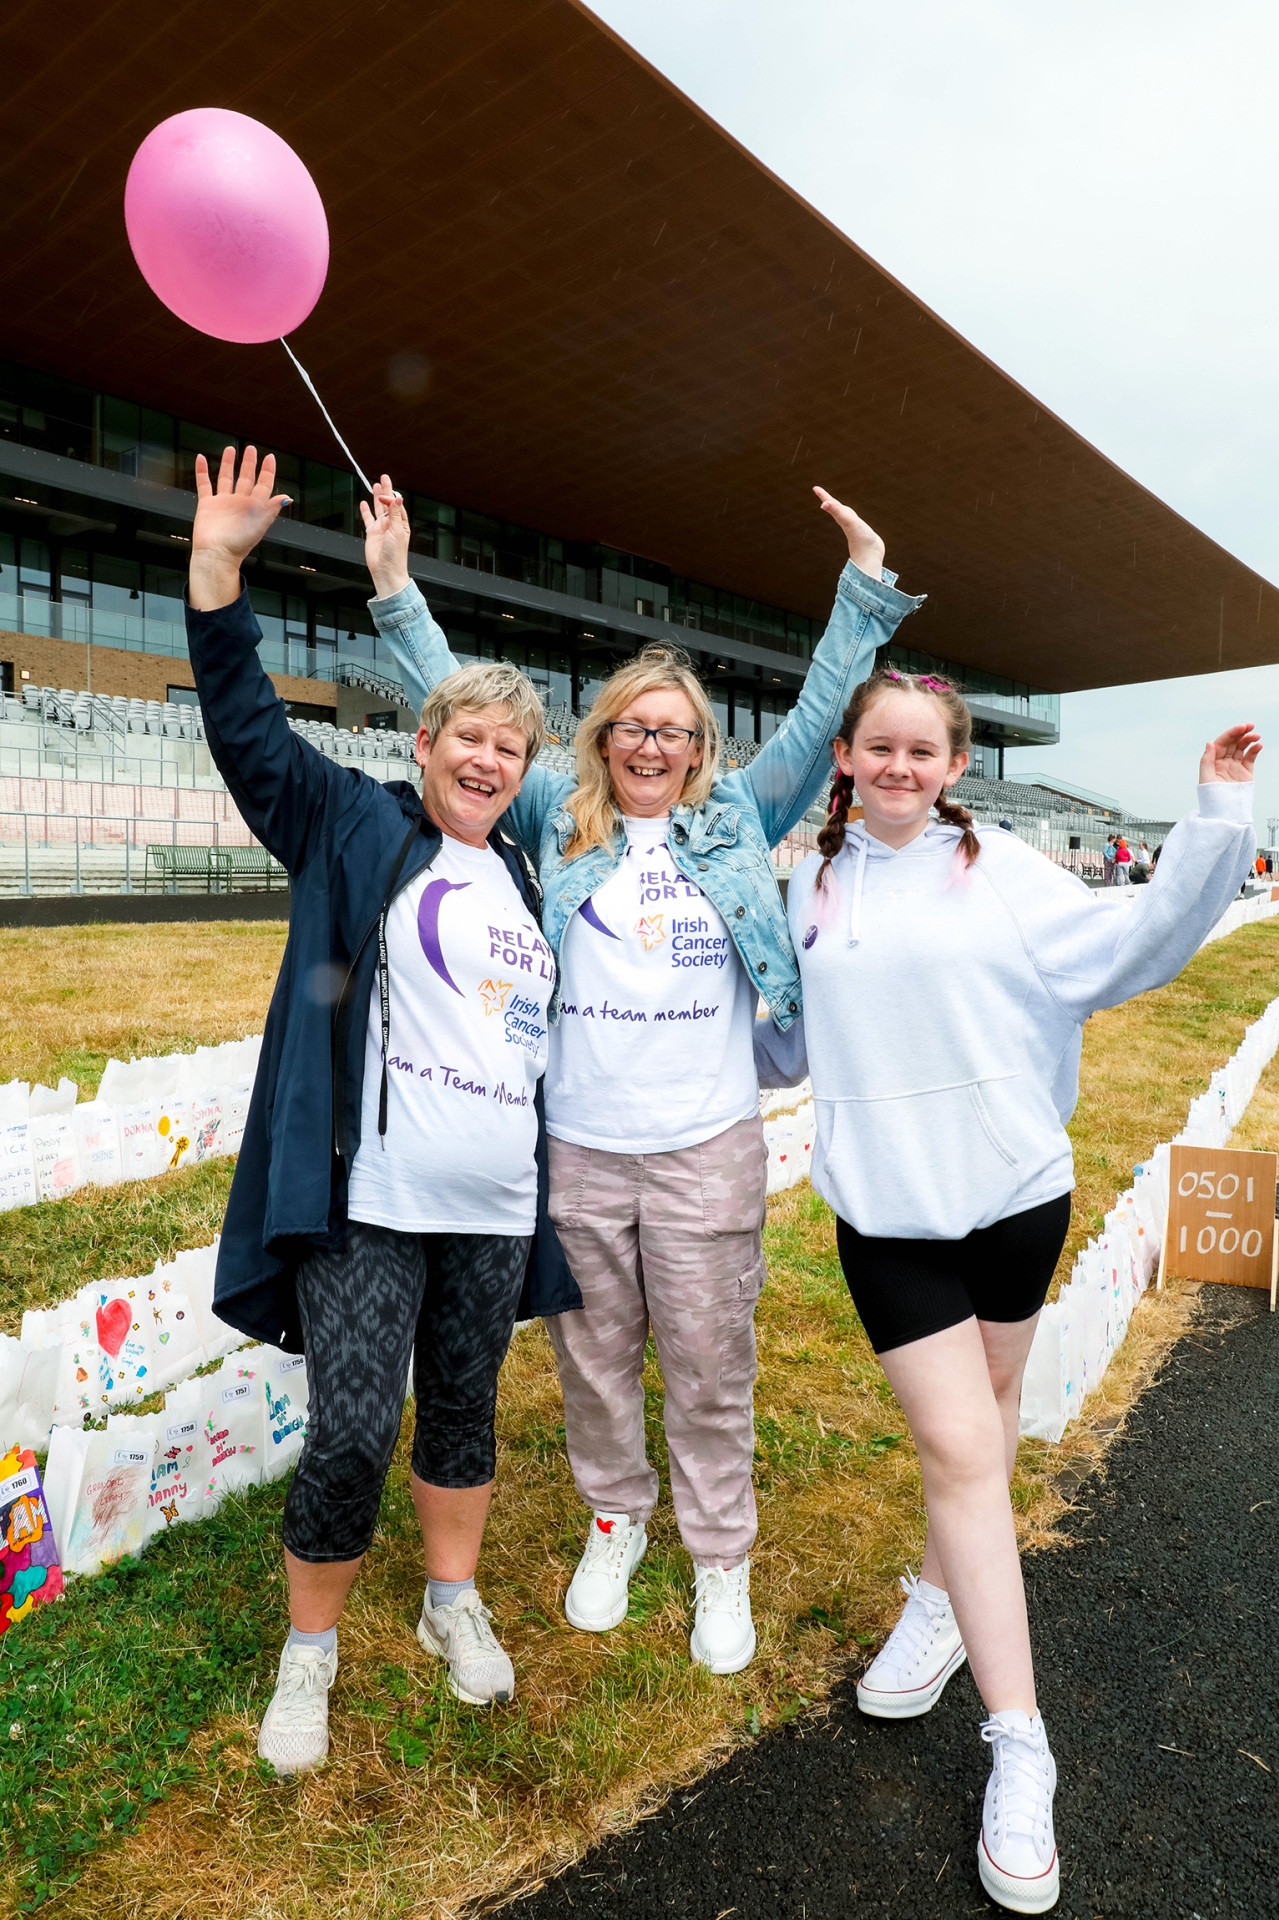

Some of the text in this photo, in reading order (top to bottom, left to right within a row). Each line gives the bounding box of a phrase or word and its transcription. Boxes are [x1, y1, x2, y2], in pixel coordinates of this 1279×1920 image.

[671, 917, 708, 933] Irish
[671, 936, 727, 950] Cancer
[490, 942, 533, 973] FOR
[671, 951, 728, 969] Society
[510, 994, 540, 1018] Irish
[583, 1005, 595, 1018] a
[600, 1000, 647, 1022] team
[654, 1000, 719, 1021] member
[504, 1011, 547, 1039] Cancer
[505, 1027, 540, 1058] Society
[388, 1056, 529, 1106] am a Team Memb
[0, 1143, 28, 1157] ICK
[1178, 1171, 1254, 1202] 0501
[1180, 1225, 1262, 1257] 1000
[235, 1387, 247, 1396] 1757
[181, 1424, 194, 1433] 1758
[11, 1477, 27, 1490] 1760
